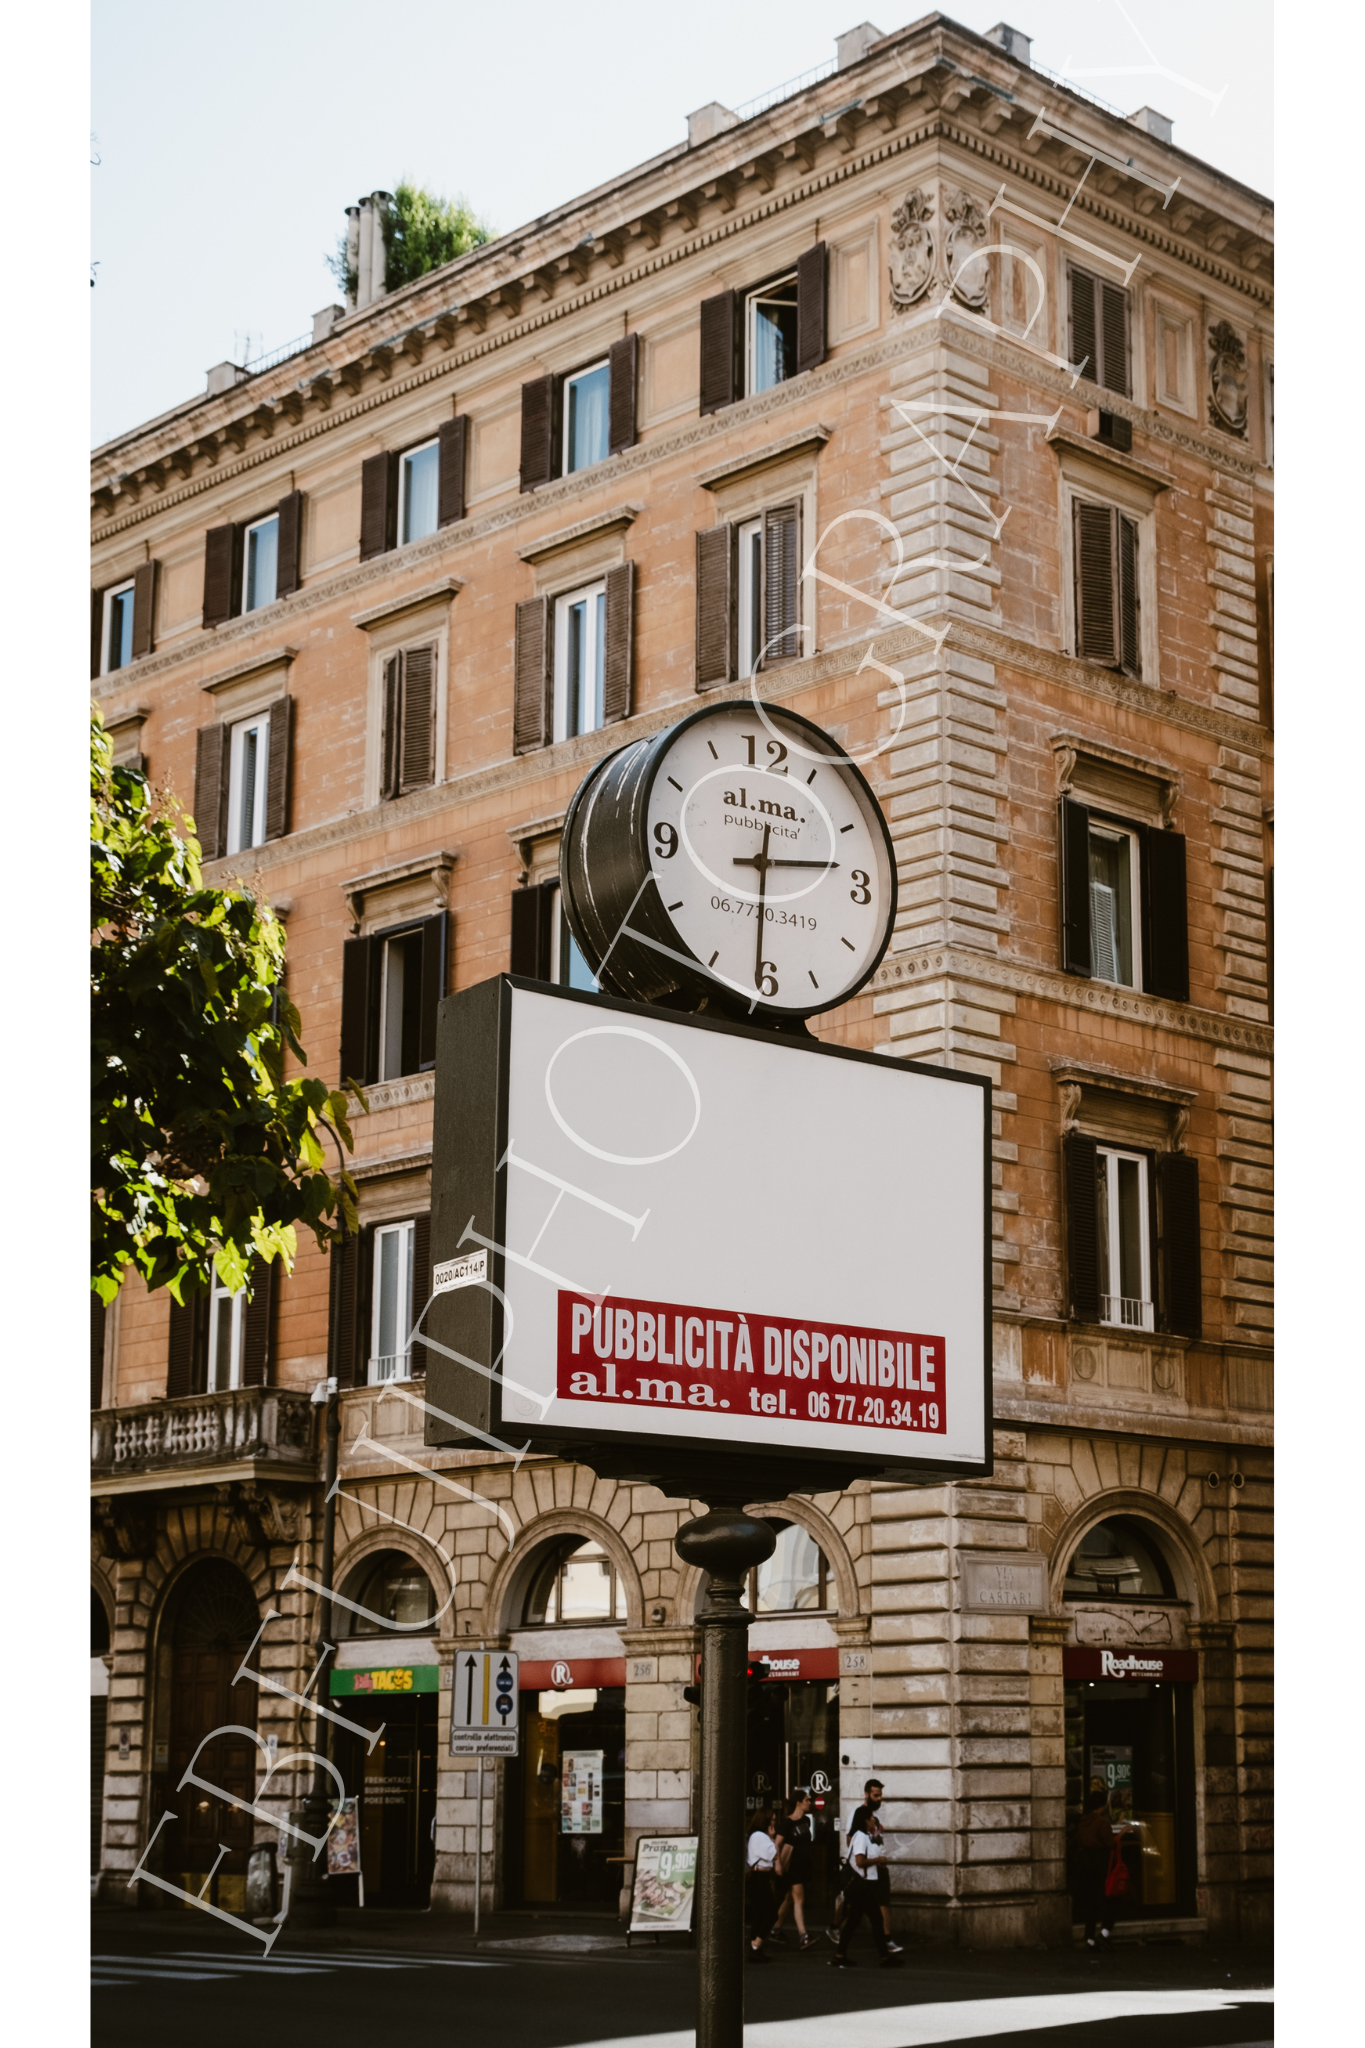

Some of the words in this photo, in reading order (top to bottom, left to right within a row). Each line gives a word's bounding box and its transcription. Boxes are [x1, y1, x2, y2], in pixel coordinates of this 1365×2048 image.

[741, 735, 788, 777] 12
[723, 788, 806, 823] al.ma.
[653, 822, 679, 859] 9
[724, 814, 801, 840] pubbicita'
[850, 870, 872, 905] 3
[755, 961, 779, 997] 6
[572, 1303, 755, 1373] PUBBLICITÀ
[763, 1326, 936, 1392] DISPONIBILE
[569, 1363, 731, 1408] al.ma.
[749, 1387, 797, 1415] tel.
[808, 1391, 830, 1419] 06
[995, 1565, 1015, 1580] VIA
[979, 1591, 1032, 1605] CARTARI
[845, 1655, 865, 1669] 258
[1100, 1650, 1164, 1679] Roadhouse
[642, 1843, 678, 1852] Pranzo
